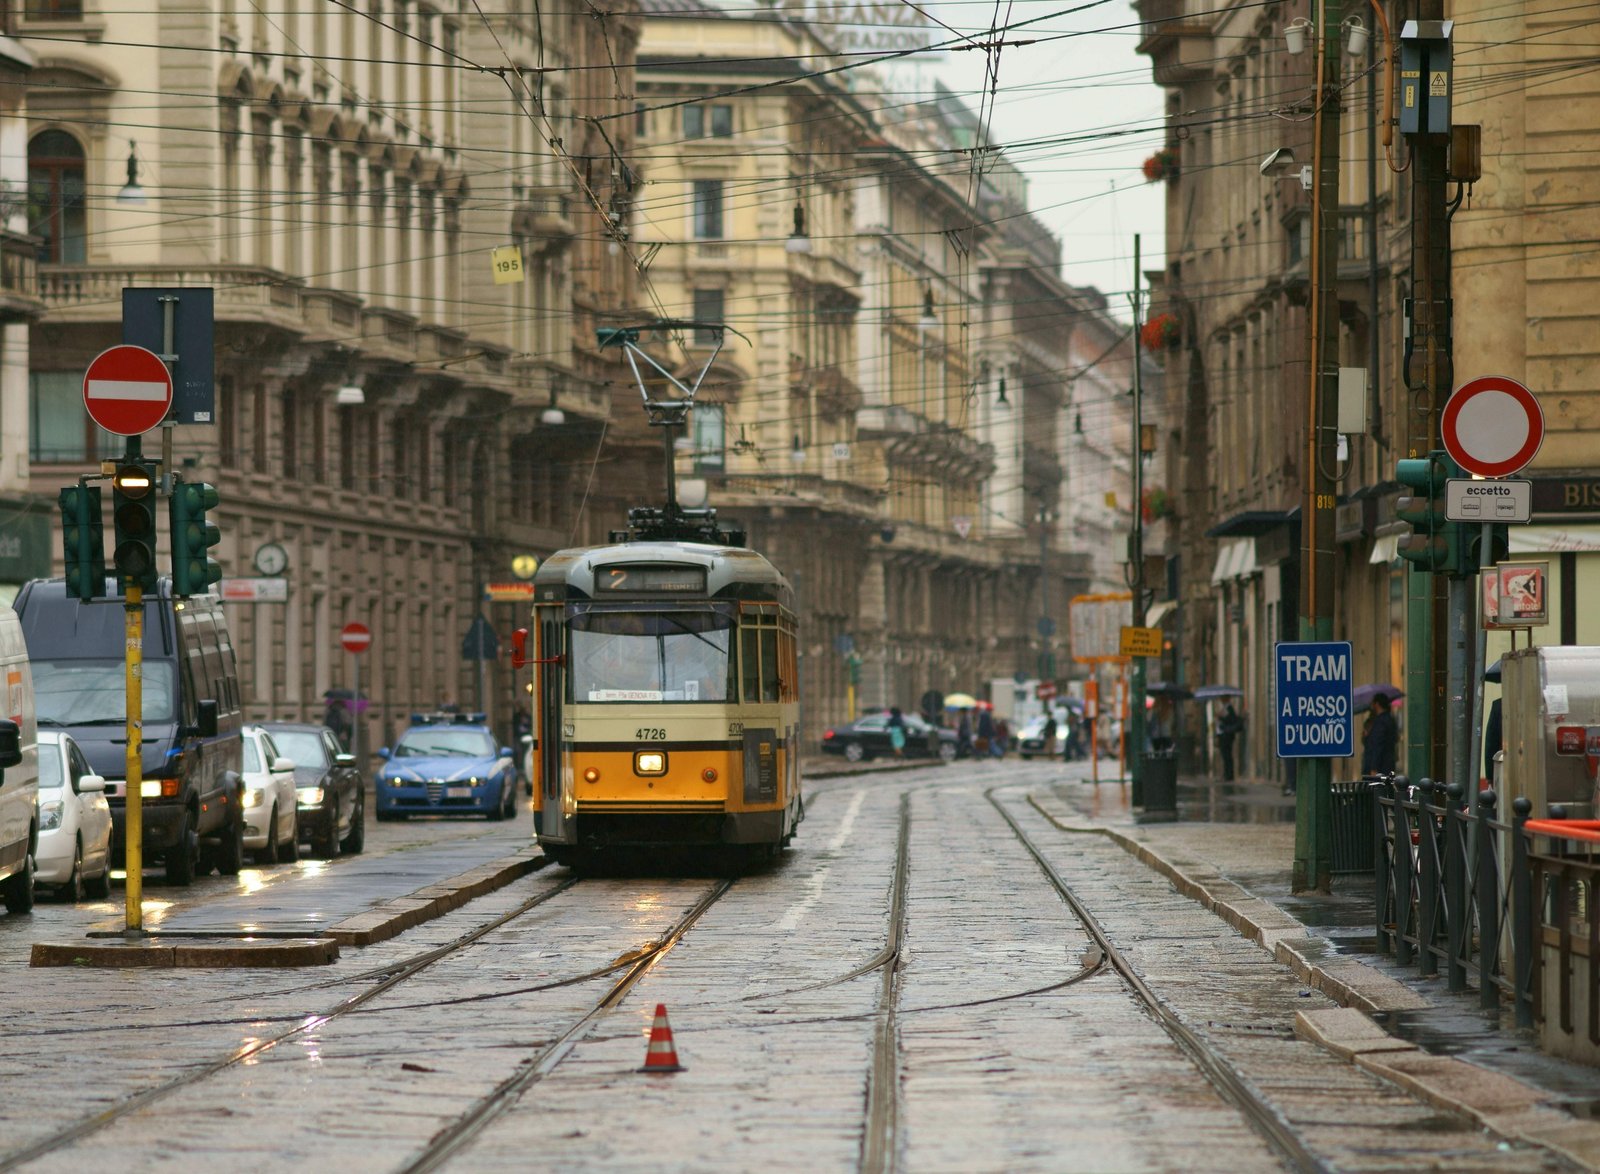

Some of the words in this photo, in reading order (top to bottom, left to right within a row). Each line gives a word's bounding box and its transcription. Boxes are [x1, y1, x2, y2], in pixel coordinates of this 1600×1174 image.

[497, 260, 518, 272] 195
[1466, 486, 1511, 495] eccetto
[610, 570, 627, 589] 2
[1281, 654, 1346, 681] TRAM
[1282, 696, 1292, 717] A
[1298, 695, 1347, 717] PASSO
[636, 728, 666, 740] 4726
[1285, 723, 1345, 745] D'UOMO
